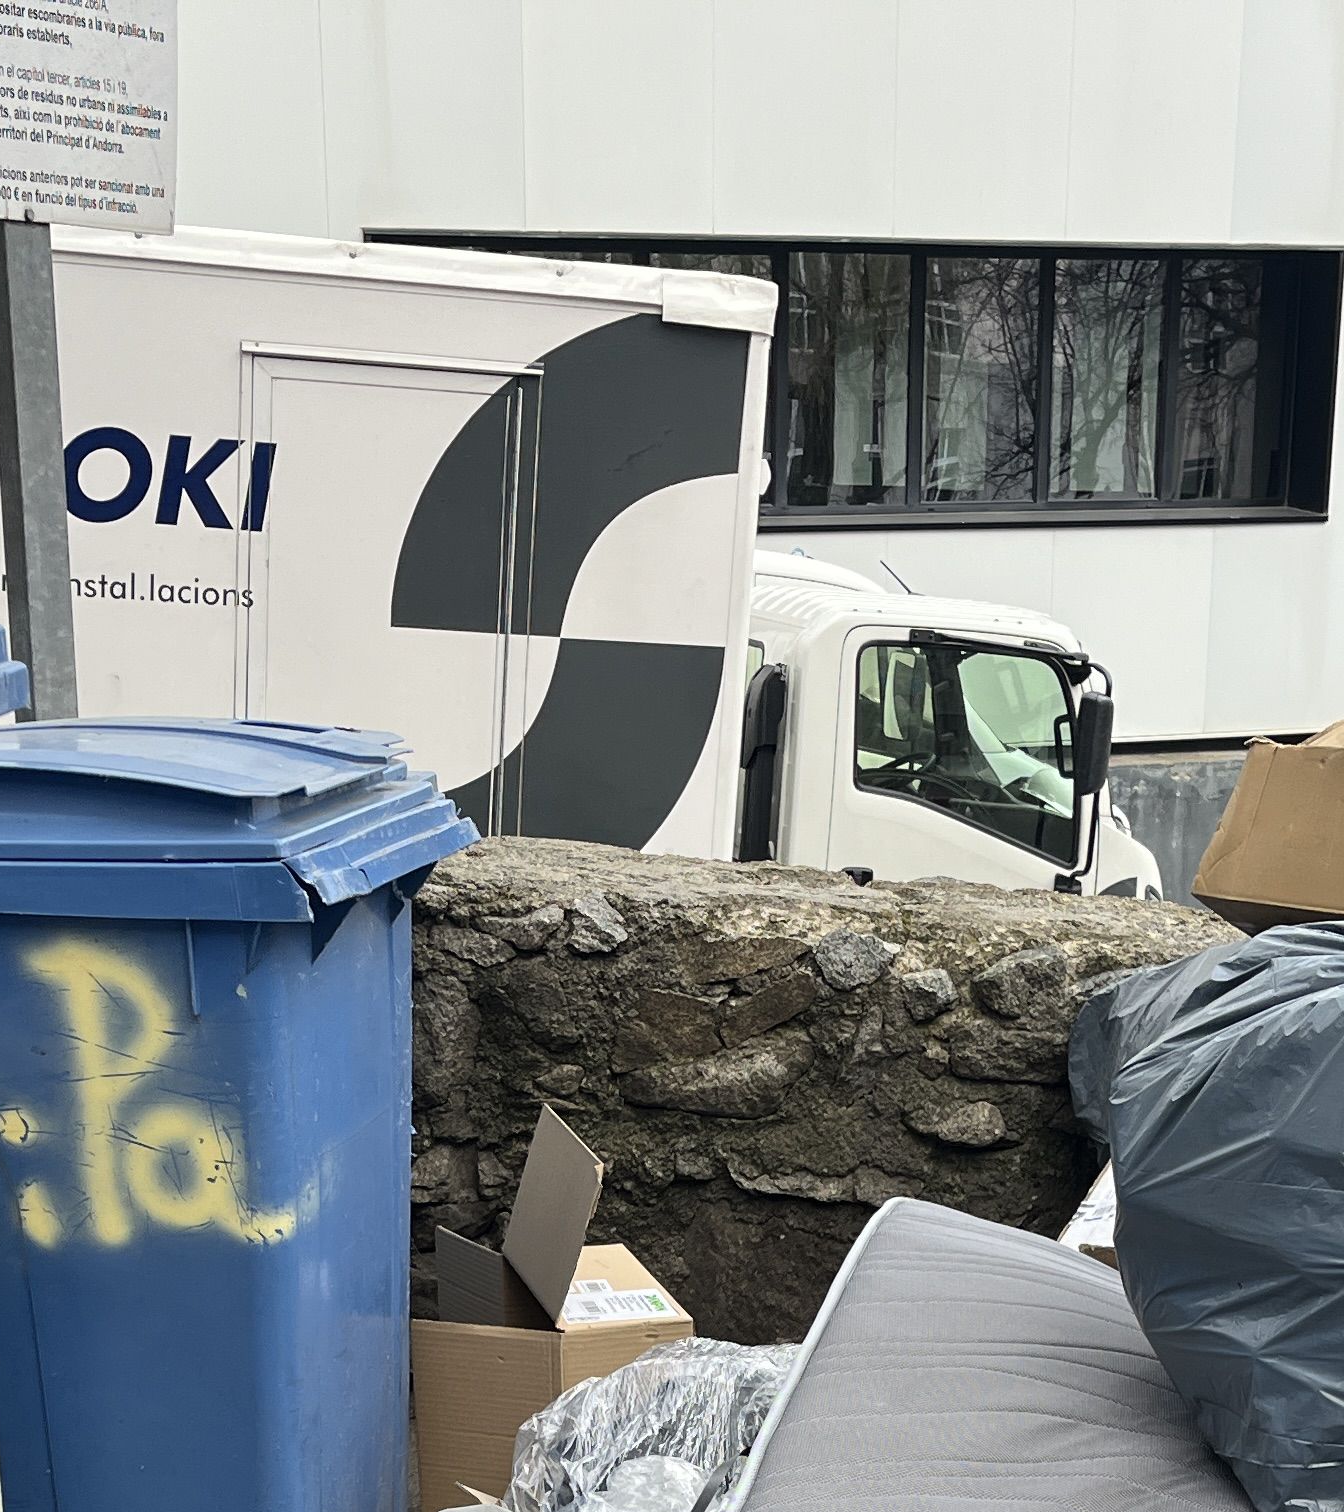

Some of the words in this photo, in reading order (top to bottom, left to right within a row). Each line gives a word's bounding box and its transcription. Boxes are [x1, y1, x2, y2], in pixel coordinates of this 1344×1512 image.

[28, 7, 86, 28] escombraries
[88, 18, 93, 29] a
[95, 17, 102, 31] la
[149, 26, 164, 42] fora
[6, 64, 15, 78] el
[102, 78, 111, 94] 15
[18, 86, 29, 100] de
[31, 89, 64, 106] residus
[66, 95, 77, 107] no
[79, 95, 106, 112] urbans
[117, 101, 161, 120] assimilables
[163, 110, 168, 121] a
[32, 111, 52, 124] com
[54, 111, 62, 125] la
[105, 118, 115, 133] de
[30, 128, 44, 142] del
[46, 129, 83, 150] Principat
[29, 170, 69, 186] anteriors
[70, 175, 83, 190] pot
[84, 178, 96, 189] ser
[98, 178, 134, 194] sancionat
[135, 184, 150, 196] amb
[152, 186, 165, 198] una
[14, 187, 19, 201] €
[21, 191, 33, 202] en
[35, 189, 63, 205] funció
[65, 192, 76, 206] del
[78, 194, 97, 211] tipus
